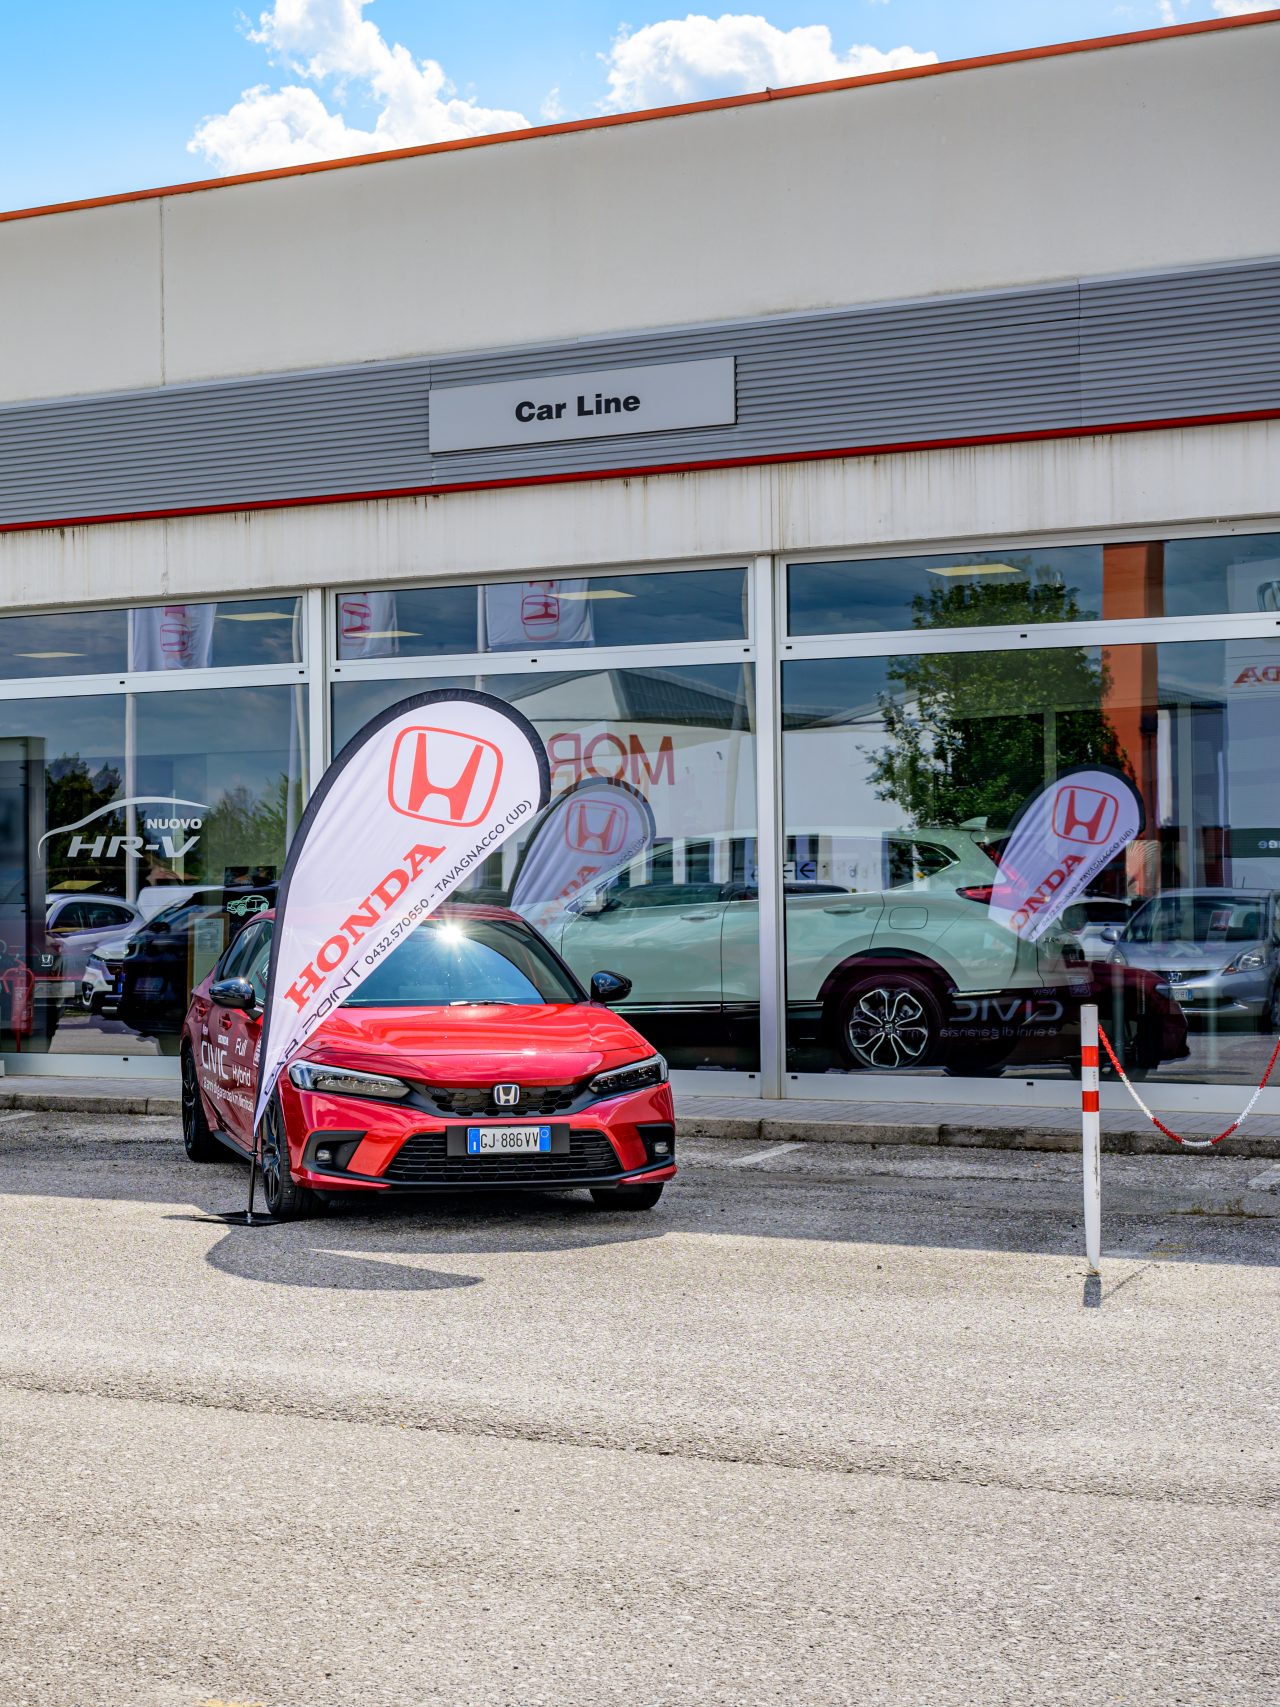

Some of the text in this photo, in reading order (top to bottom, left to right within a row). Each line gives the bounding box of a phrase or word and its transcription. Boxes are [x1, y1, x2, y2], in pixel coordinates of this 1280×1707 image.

[515, 393, 641, 422] Car Line
[146, 818, 202, 830] NUOVO
[67, 836, 201, 858] HR-V
[1010, 853, 1088, 932] ONDA
[284, 843, 447, 1014] HONDA
[302, 960, 360, 1036] POINT
[364, 898, 429, 965] 0432.570650
[434, 823, 505, 892] TAVAGNACCO
[505, 800, 532, 825] (UD)
[201, 1040, 229, 1080] CIVIC
